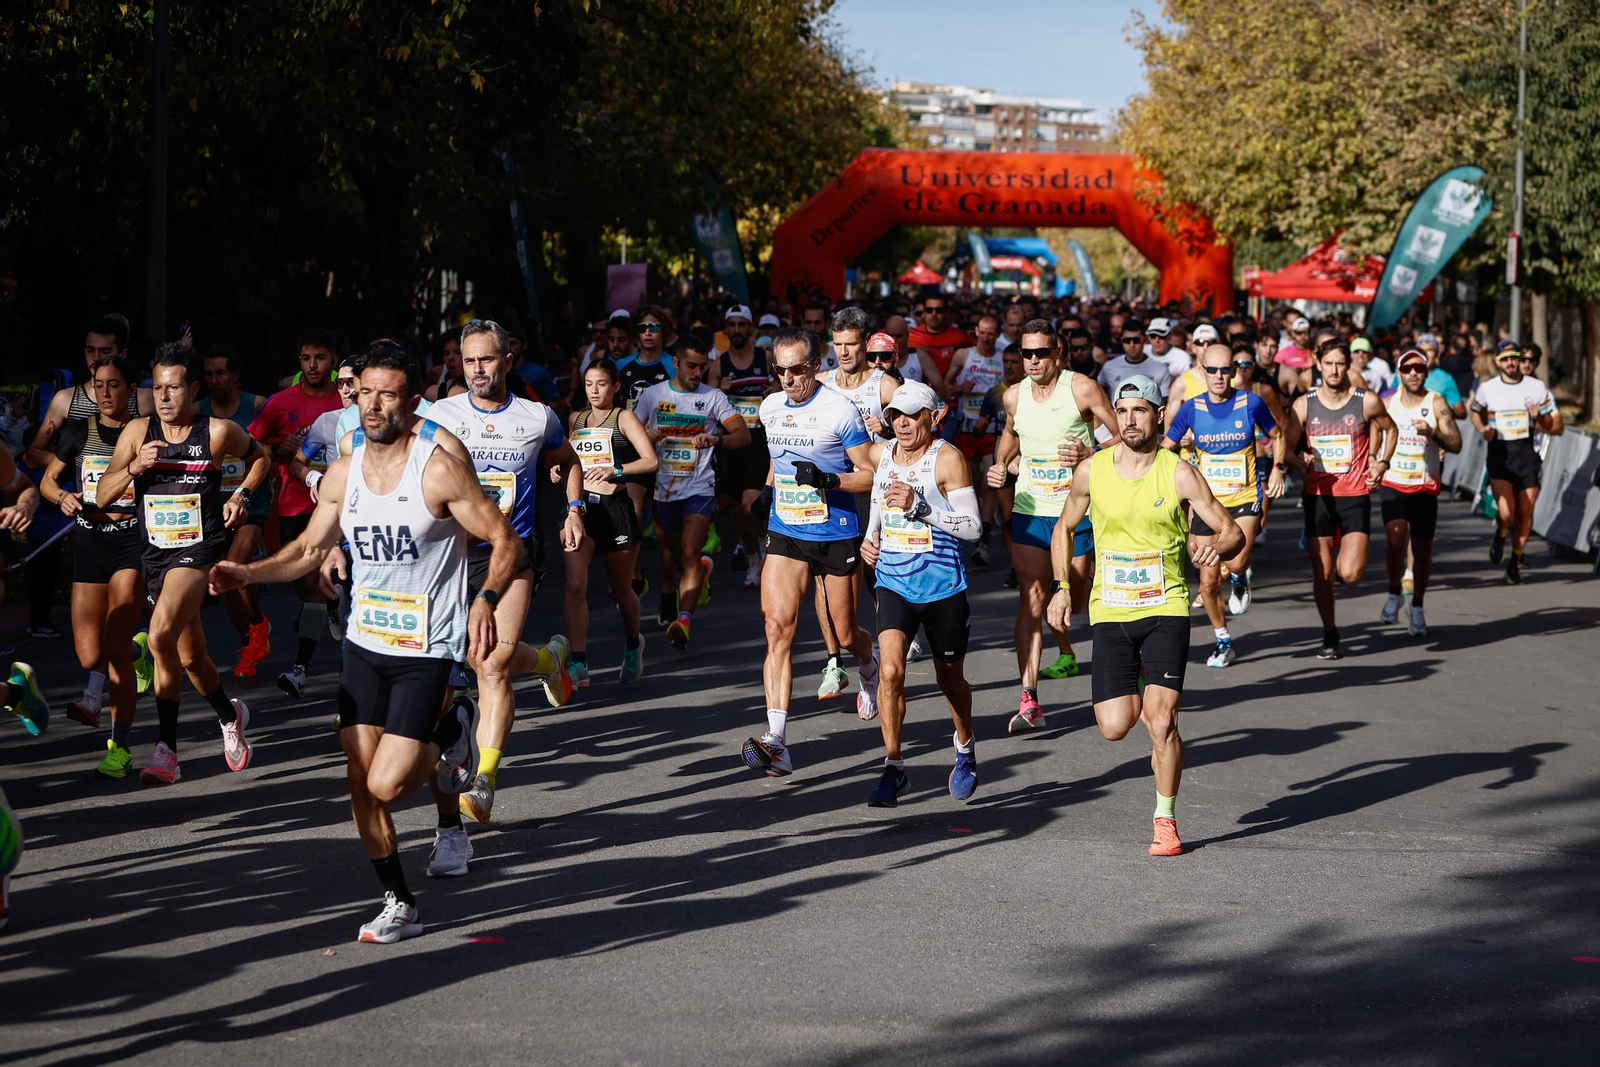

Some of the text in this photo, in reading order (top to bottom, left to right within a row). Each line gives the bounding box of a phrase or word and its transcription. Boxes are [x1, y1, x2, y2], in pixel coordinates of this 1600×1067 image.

[901, 164, 1114, 190] Universidad
[903, 191, 1108, 216] de Granada
[809, 185, 880, 248] Deportes
[1506, 419, 1520, 428] 67
[1198, 431, 1247, 445] agustinos
[576, 441, 603, 452] 496
[1318, 448, 1345, 457] 750
[469, 450, 526, 462] ARACENA
[664, 450, 691, 460] 758
[1396, 460, 1417, 471] 113
[156, 474, 208, 484] rundata
[1206, 467, 1242, 478] 1489
[779, 490, 821, 505] 1509
[154, 511, 190, 525] 932
[97, 520, 129, 532] NIKE
[353, 525, 420, 562] ENA
[1115, 568, 1151, 584] 241
[362, 609, 418, 631] 1519
